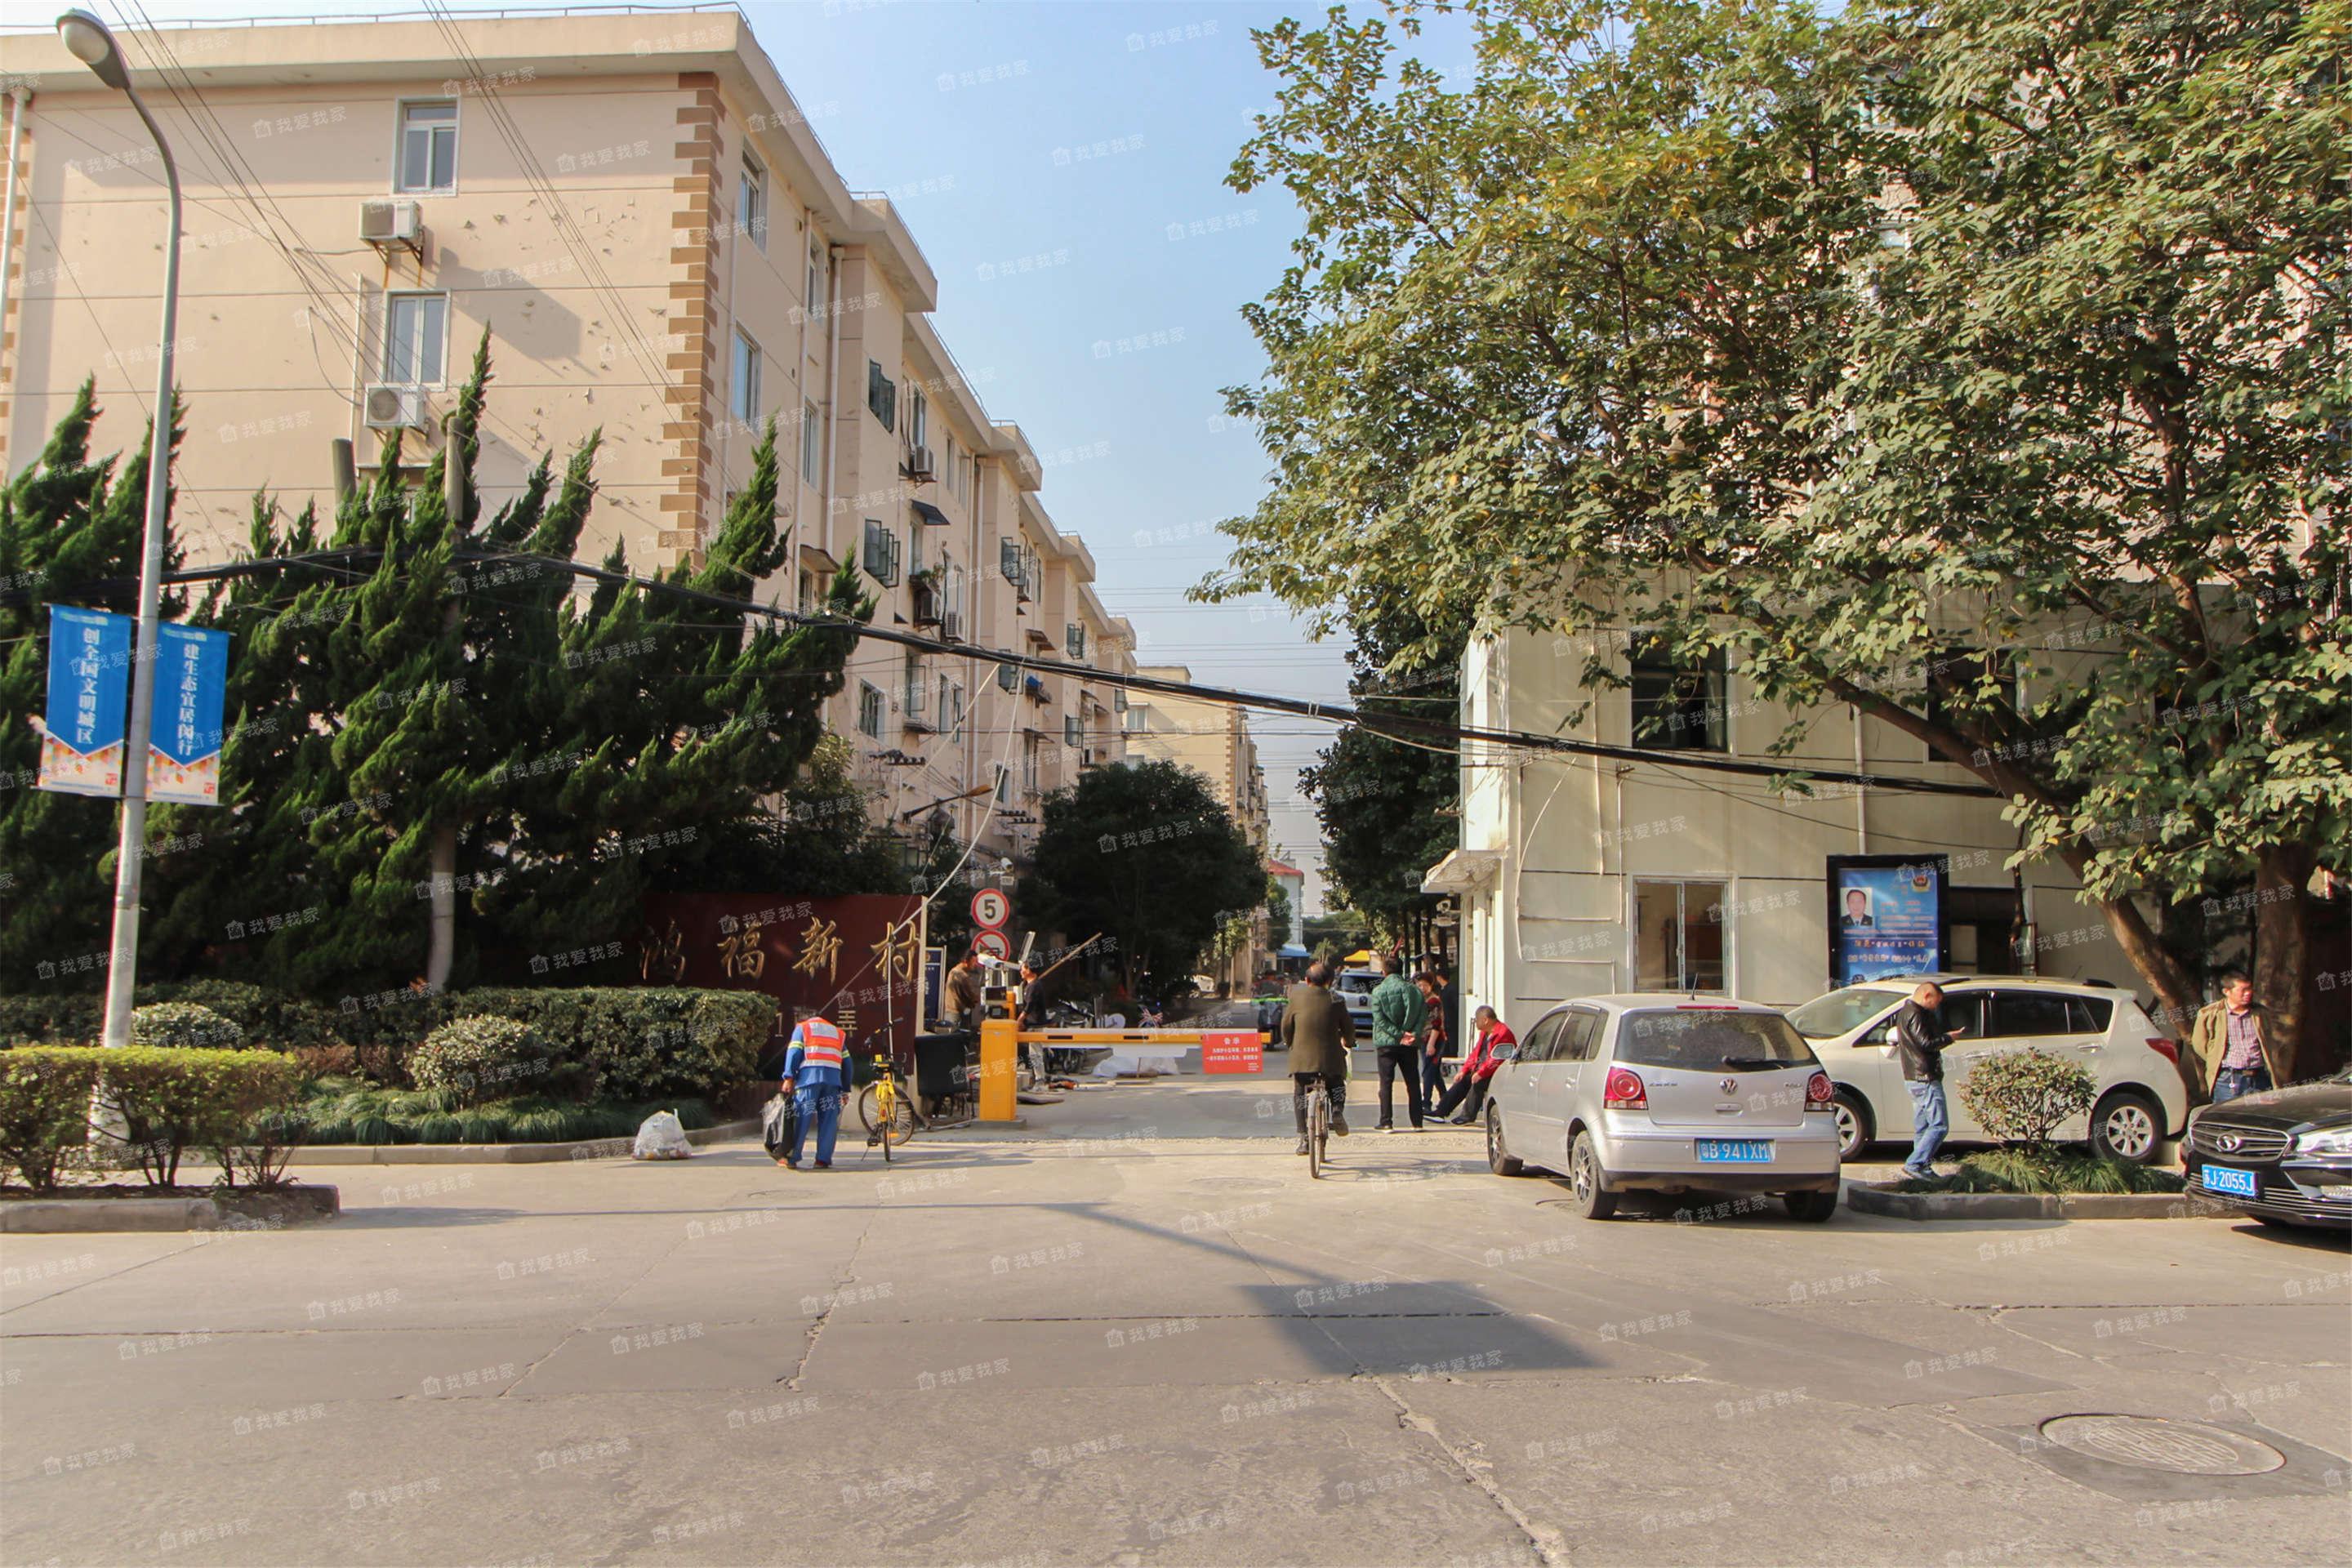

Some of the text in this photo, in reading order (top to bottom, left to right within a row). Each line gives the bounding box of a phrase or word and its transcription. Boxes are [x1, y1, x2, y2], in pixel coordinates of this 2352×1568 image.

[77, 627, 100, 745] 创全国文明城区
[177, 643, 200, 756] 建生态宜居闵行
[639, 916, 920, 987] 鸿福新村
[984, 899, 996, 920] 5
